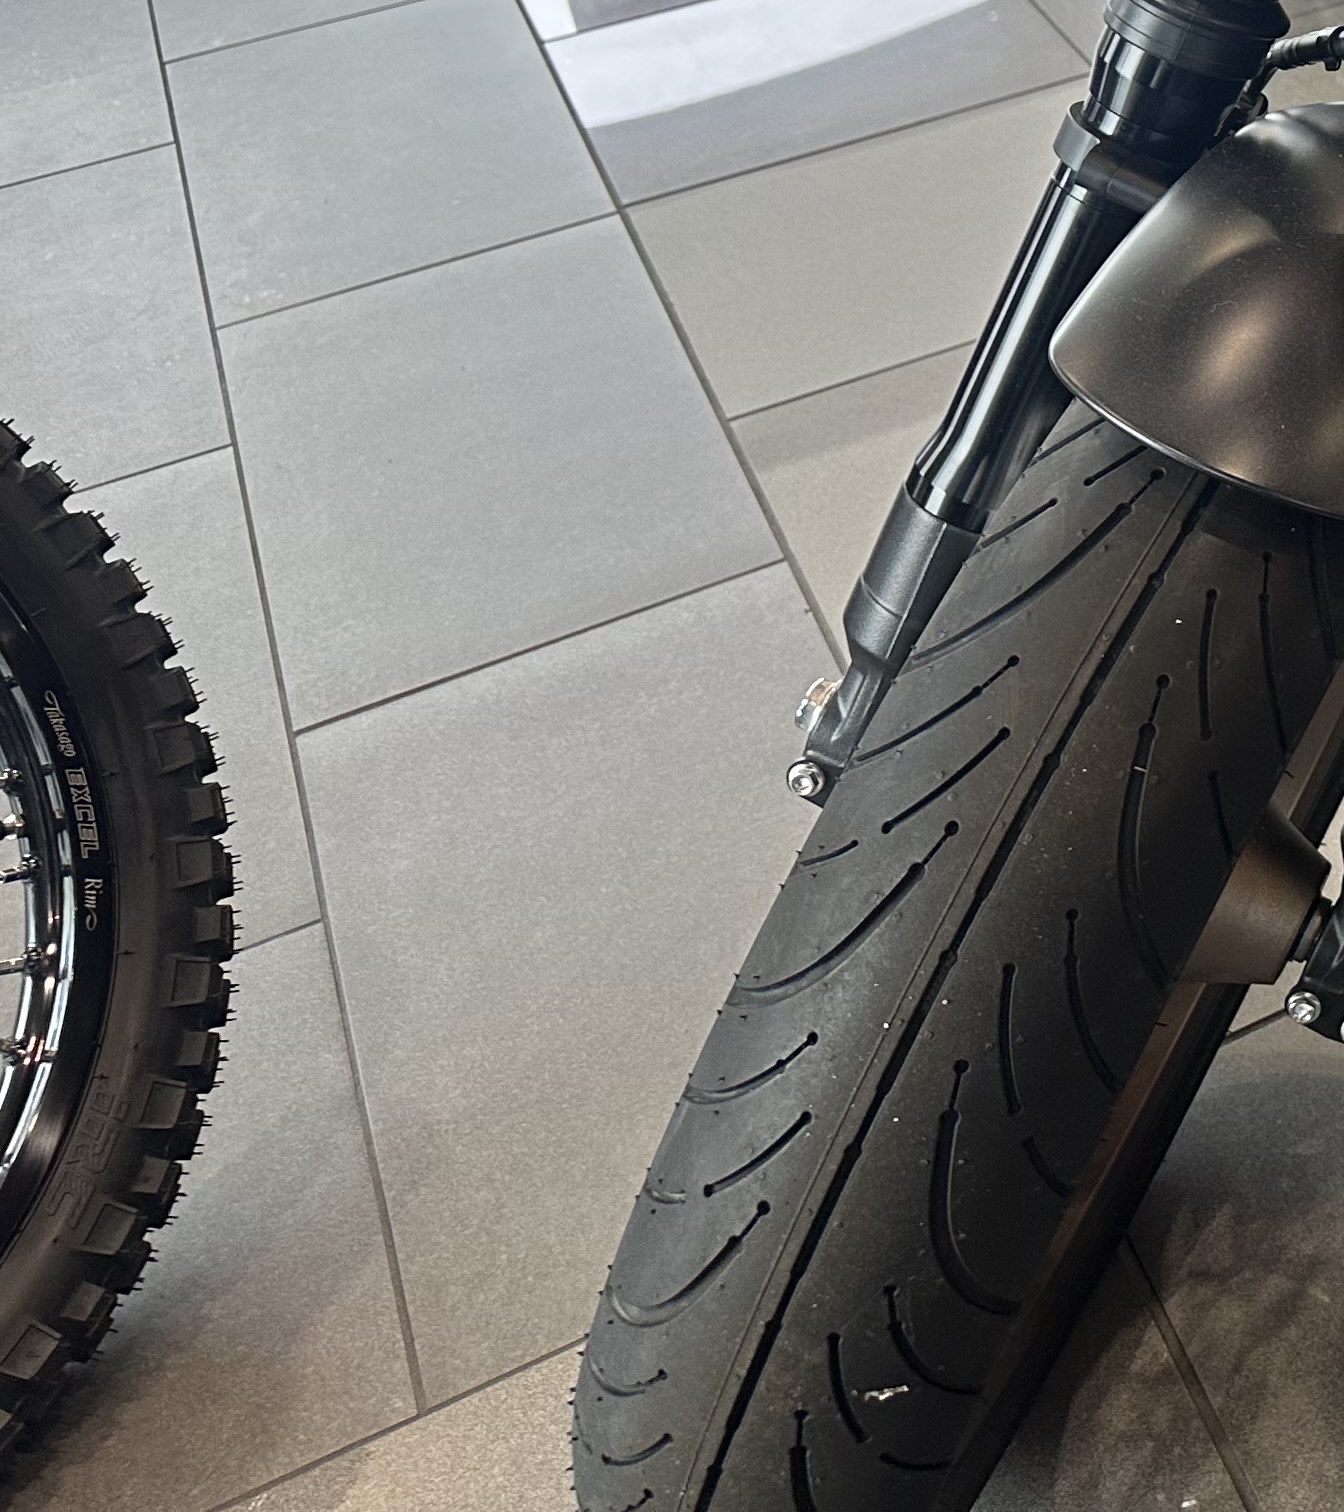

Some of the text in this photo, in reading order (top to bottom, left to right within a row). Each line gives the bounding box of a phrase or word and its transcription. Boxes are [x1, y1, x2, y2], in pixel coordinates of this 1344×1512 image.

[43, 689, 104, 932] Takasago EXCEL Rim
